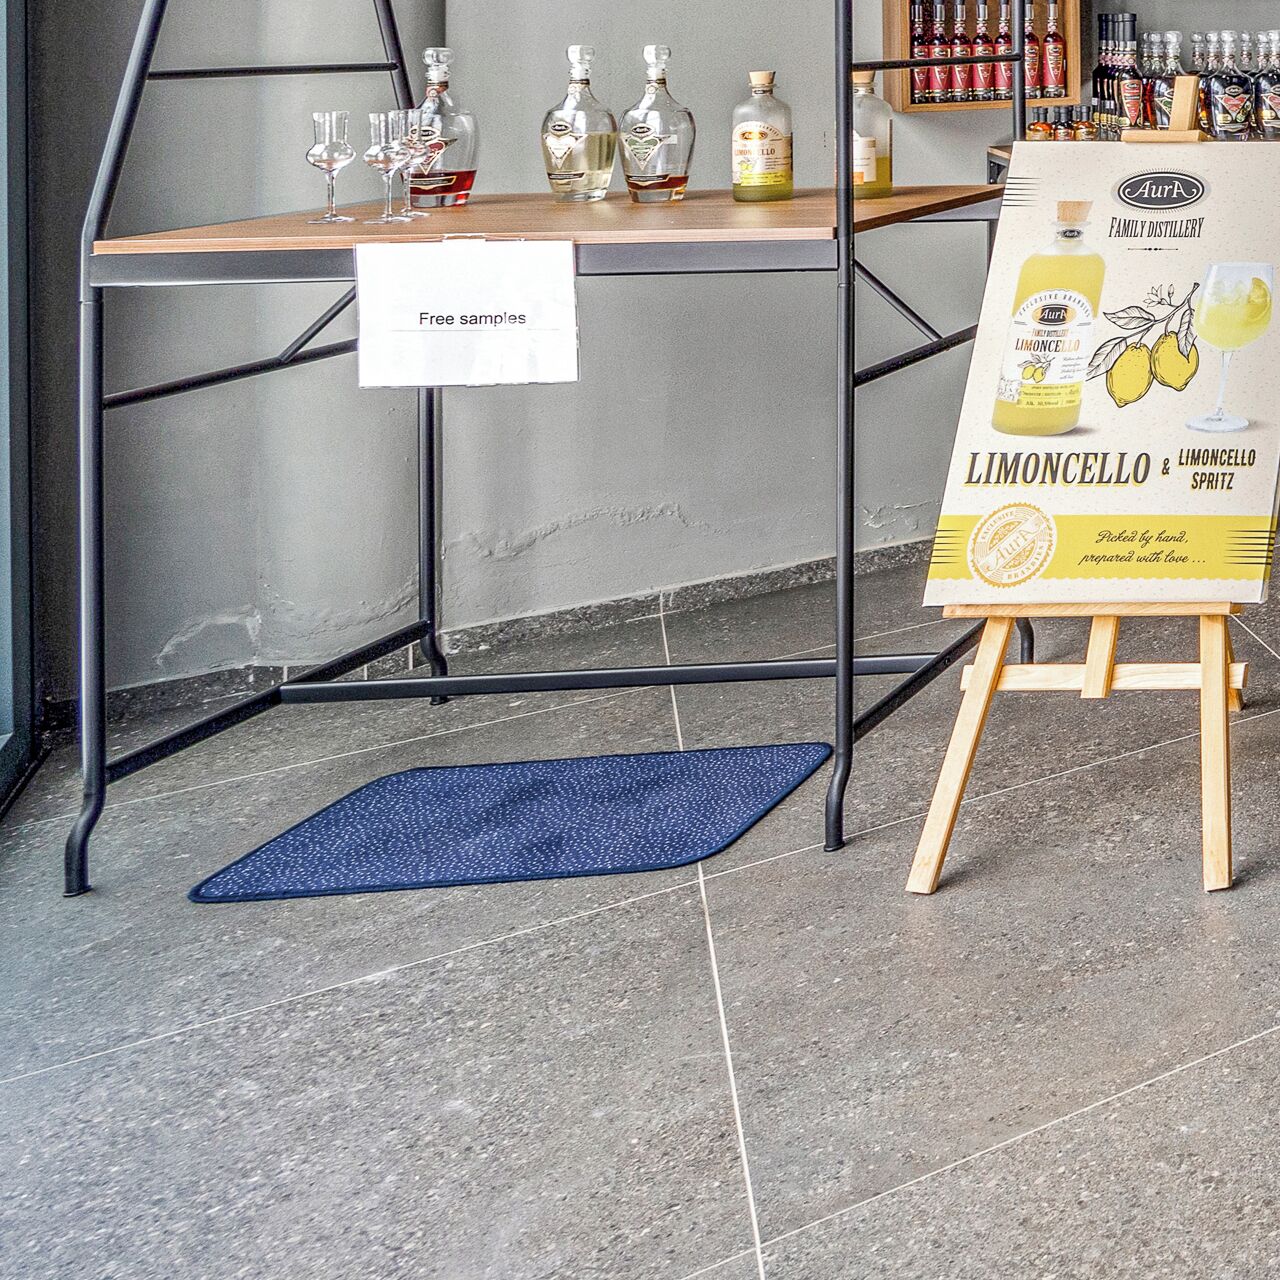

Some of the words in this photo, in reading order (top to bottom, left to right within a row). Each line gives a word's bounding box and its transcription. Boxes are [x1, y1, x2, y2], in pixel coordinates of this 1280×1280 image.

[1125, 180, 1197, 199] AurA
[1108, 217, 1146, 238] FAMILY
[1147, 217, 1205, 238] DISTILLERY
[419, 312, 455, 326] Free
[459, 311, 527, 327] samples
[1015, 338, 1080, 353] LIMONCELLO
[1178, 447, 1257, 467] LIMONCELLO
[964, 451, 1152, 486] LIMONCELLO
[1161, 457, 1171, 475] &
[1190, 472, 1235, 491] SPRITZ
[1096, 529, 1138, 544] Picked
[1138, 529, 1154, 549] by
[1155, 529, 1189, 544] hand,
[1078, 550, 1135, 567] prepared
[1135, 550, 1163, 564] with
[1163, 550, 1190, 564] love
